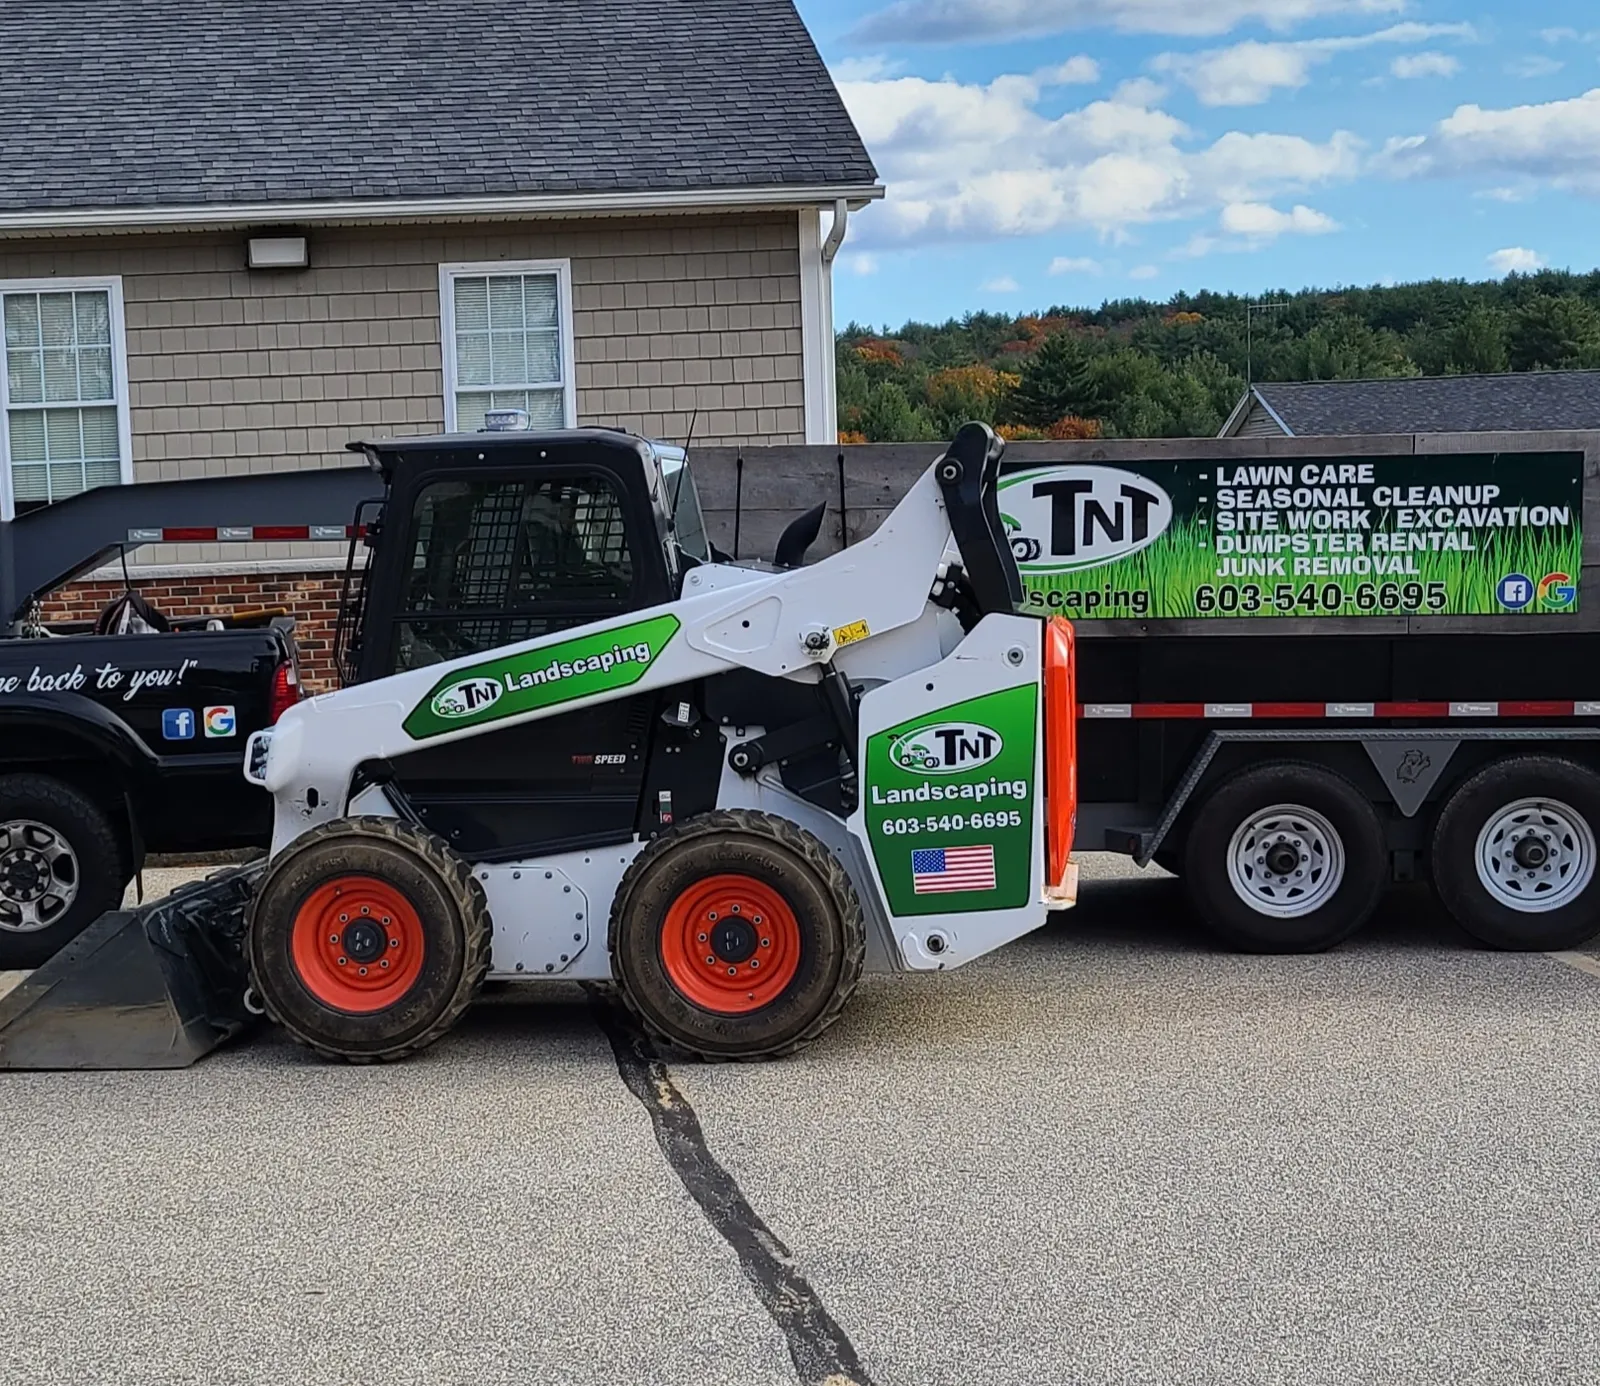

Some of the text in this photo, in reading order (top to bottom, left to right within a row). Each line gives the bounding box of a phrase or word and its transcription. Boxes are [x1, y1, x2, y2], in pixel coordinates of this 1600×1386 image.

[1216, 466, 1293, 486] LAWN
[1300, 464, 1375, 485] CARE
[1216, 487, 1365, 509] SEASONAL
[1372, 485, 1500, 507] CLEANUP
[1032, 480, 1160, 556] TNT
[1216, 511, 1279, 531] SITE
[1286, 509, 1371, 531] WORK
[1397, 506, 1569, 528] EXCAVATION
[1216, 533, 1364, 554] DUMPSTER
[1372, 531, 1476, 552] RENTAL
[1216, 556, 1420, 577] JUNK REMOVAL
[1022, 584, 1149, 614] scaping
[1195, 581, 1448, 613] 603-540-6695
[27, 664, 87, 693] back
[95, 662, 125, 689] to
[458, 642, 651, 709] TNT Landscaping
[594, 754, 627, 765] SPEED
[934, 729, 997, 766] TNT
[871, 777, 1027, 804] Landscaping
[882, 811, 1021, 835] 603-540-6695
